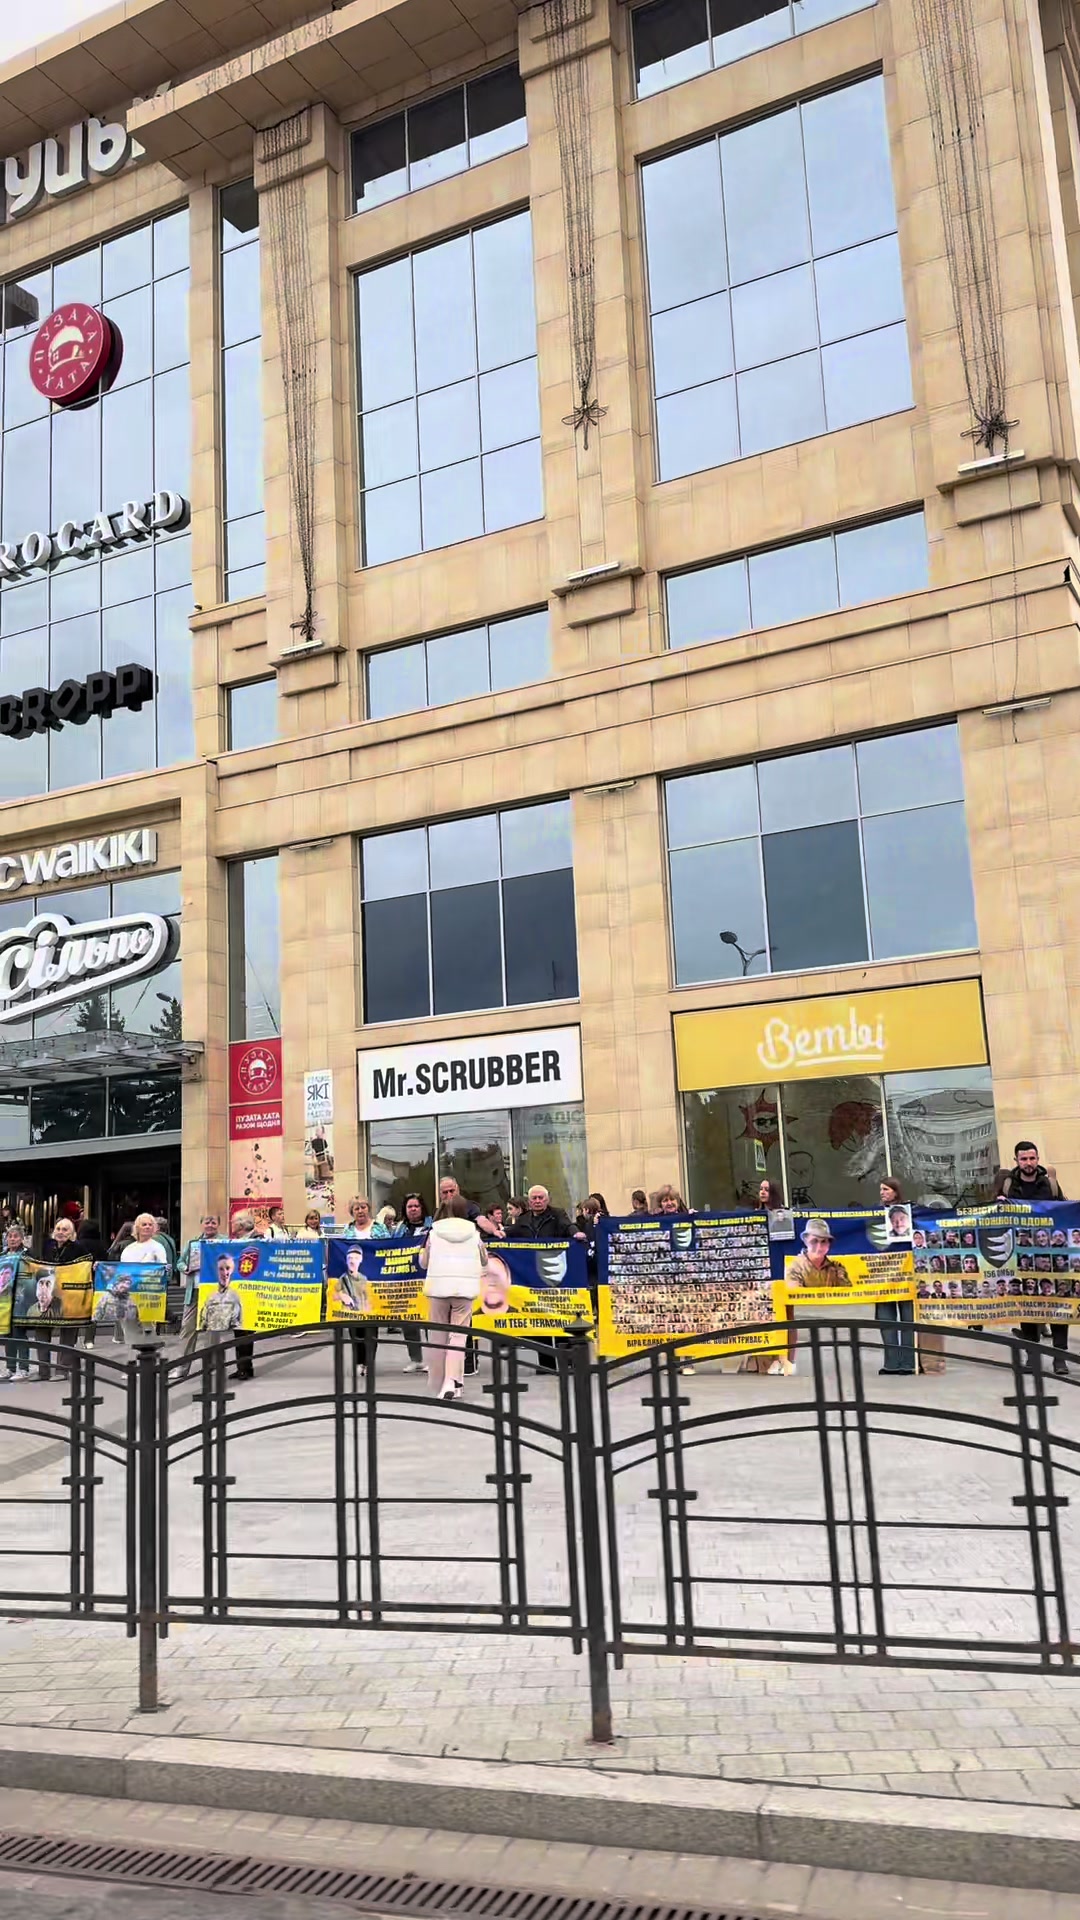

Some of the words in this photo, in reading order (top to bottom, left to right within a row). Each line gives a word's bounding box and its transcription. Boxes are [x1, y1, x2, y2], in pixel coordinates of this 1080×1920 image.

[34, 308, 98, 363] ПУЗАТА
[42, 361, 91, 390] ХАТА
[0, 663, 150, 737] CROPP
[0, 927, 151, 1001] Сільпо
[757, 1006, 888, 1070] Bembi
[235, 1114, 261, 1123] ПУЗАТА
[262, 1112, 280, 1121] ХАТА
[235, 1122, 256, 1130] РАЗОМ
[256, 1119, 281, 1129] ЩОДНЯ
[956, 1204, 998, 1216] БЕЗВІСТИ
[979, 1216, 1019, 1226] КОЖНОГО
[1020, 1217, 1054, 1227] ВДОМА
[984, 1270, 996, 1278] 156
[494, 1319, 507, 1328] МИ
[509, 1318, 528, 1328] ТЕБЕ
[627, 1339, 642, 1348] ВІРА
